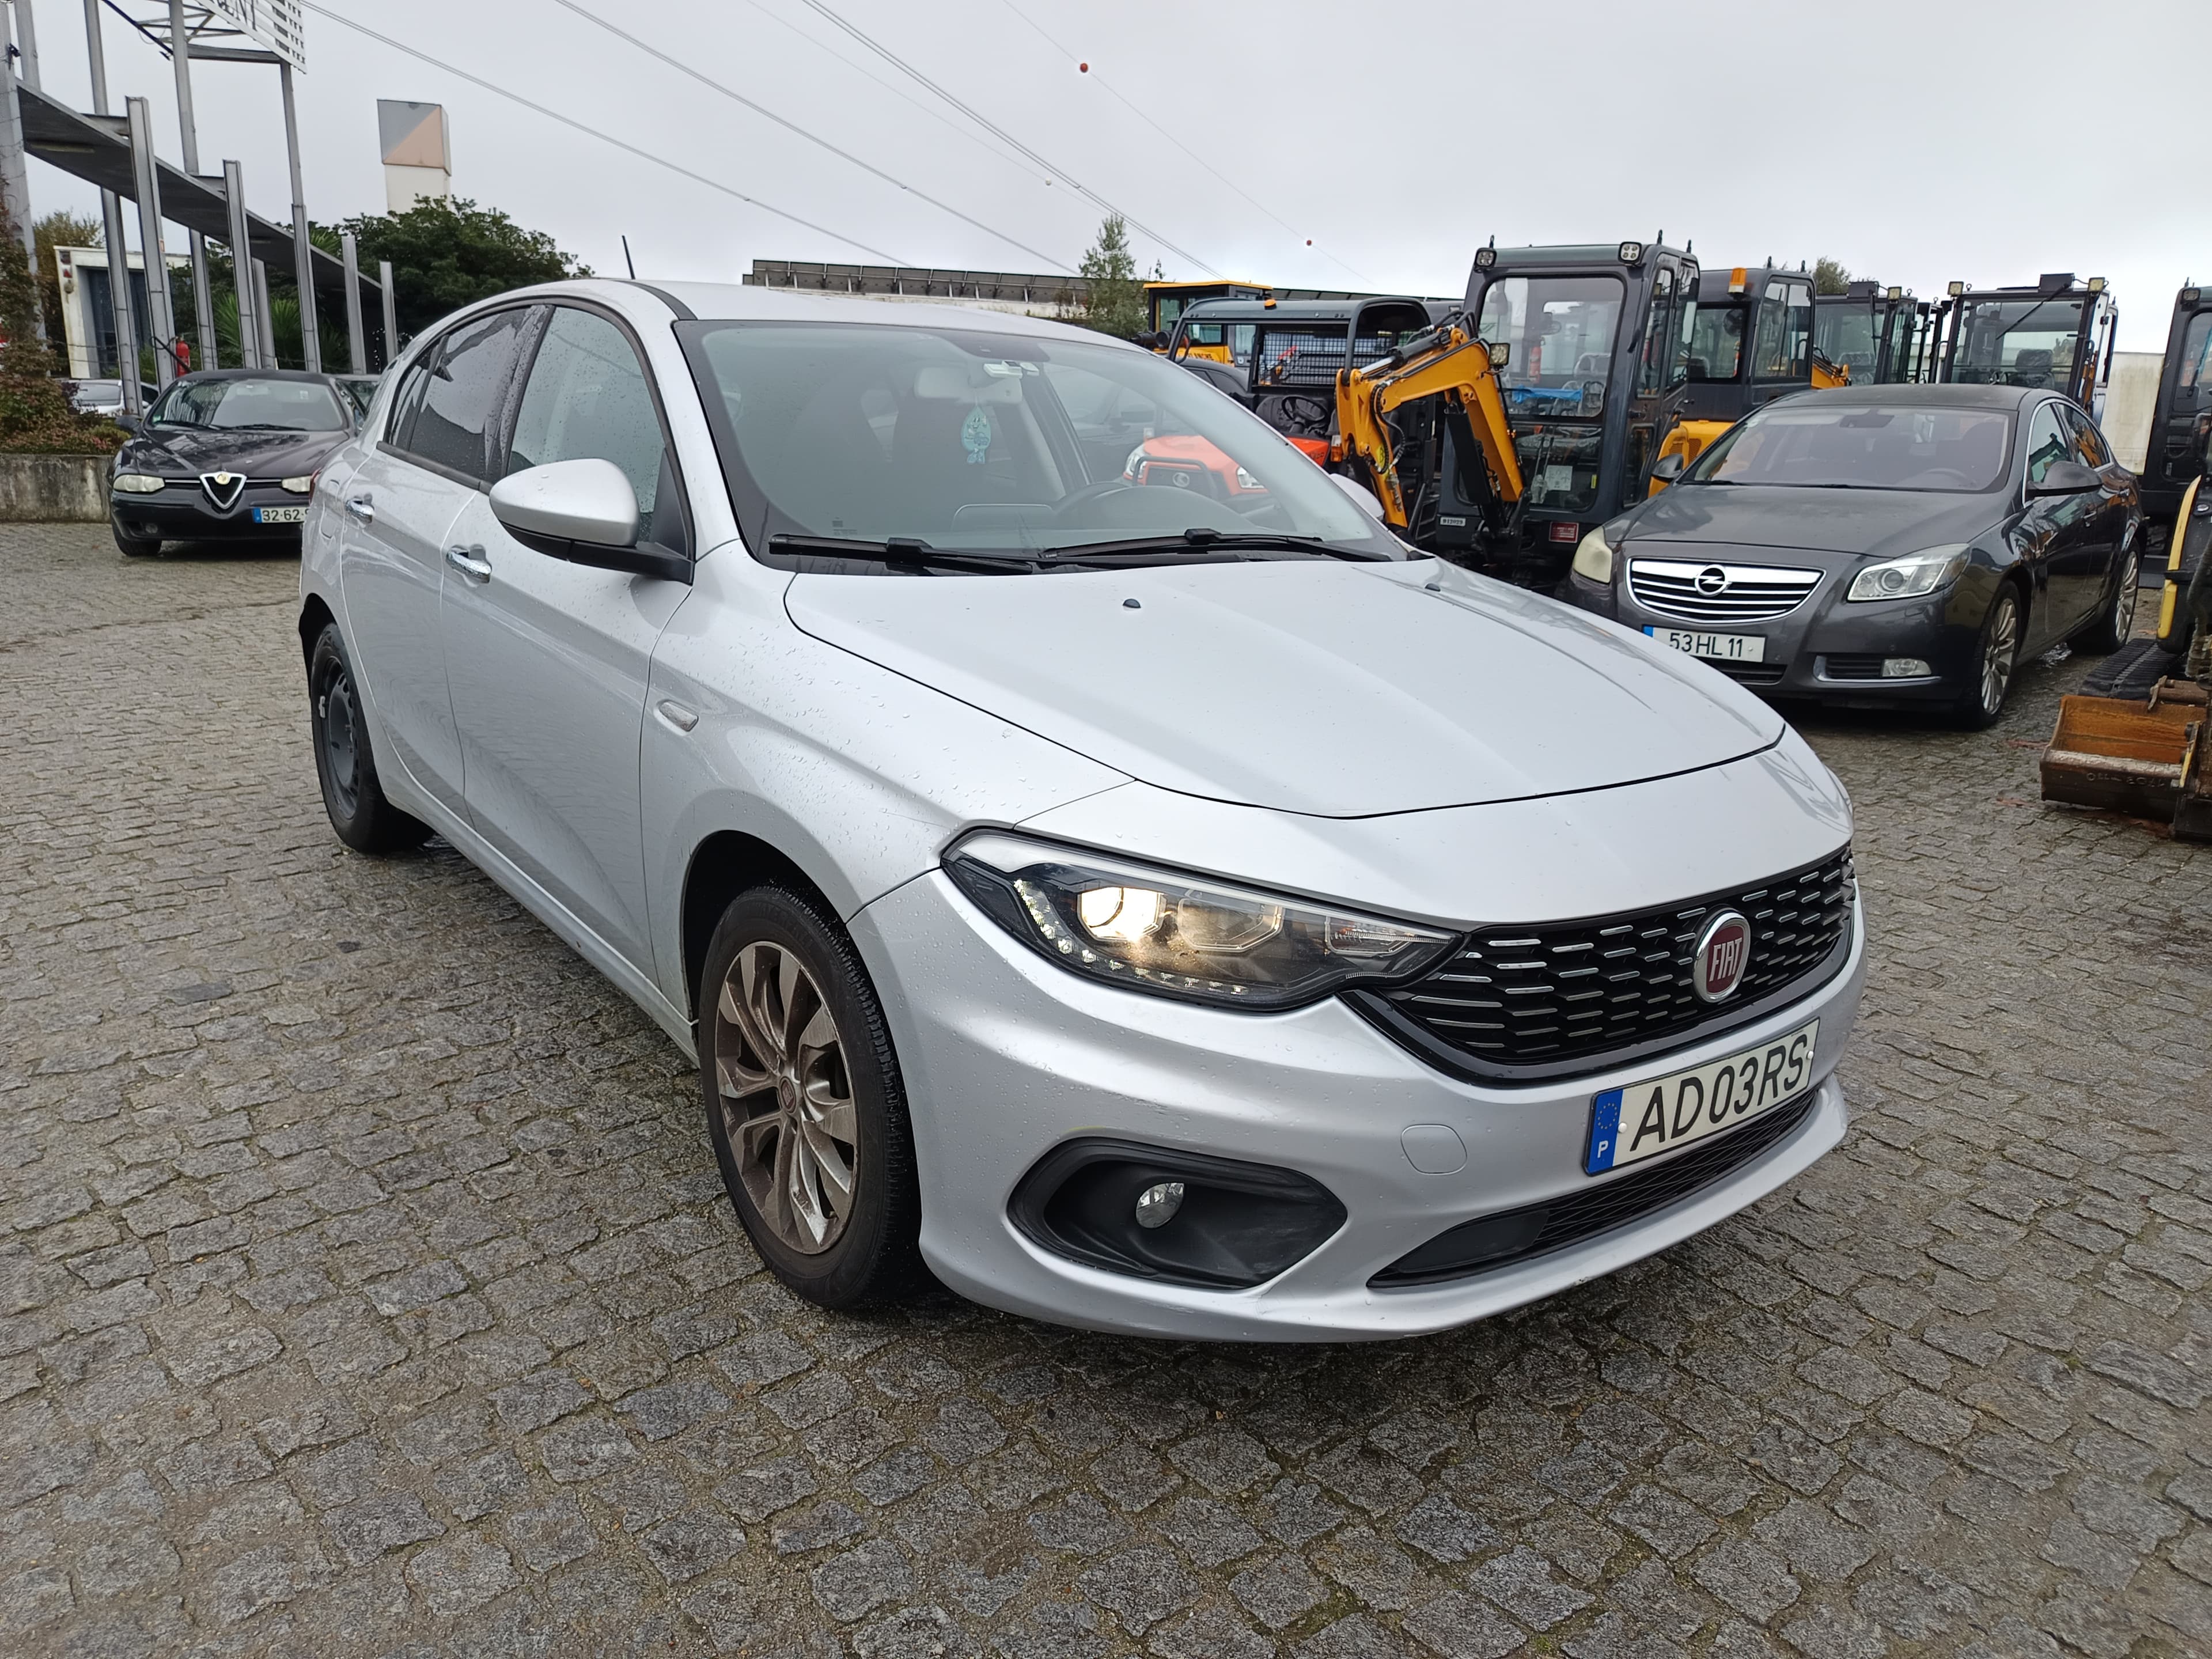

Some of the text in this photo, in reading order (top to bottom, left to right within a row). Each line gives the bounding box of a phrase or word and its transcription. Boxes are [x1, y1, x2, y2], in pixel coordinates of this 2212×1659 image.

[1669, 632, 1743, 658] 53 HL 11
[1709, 937, 1743, 982] FIAT
[1597, 1140, 1609, 1158] P
